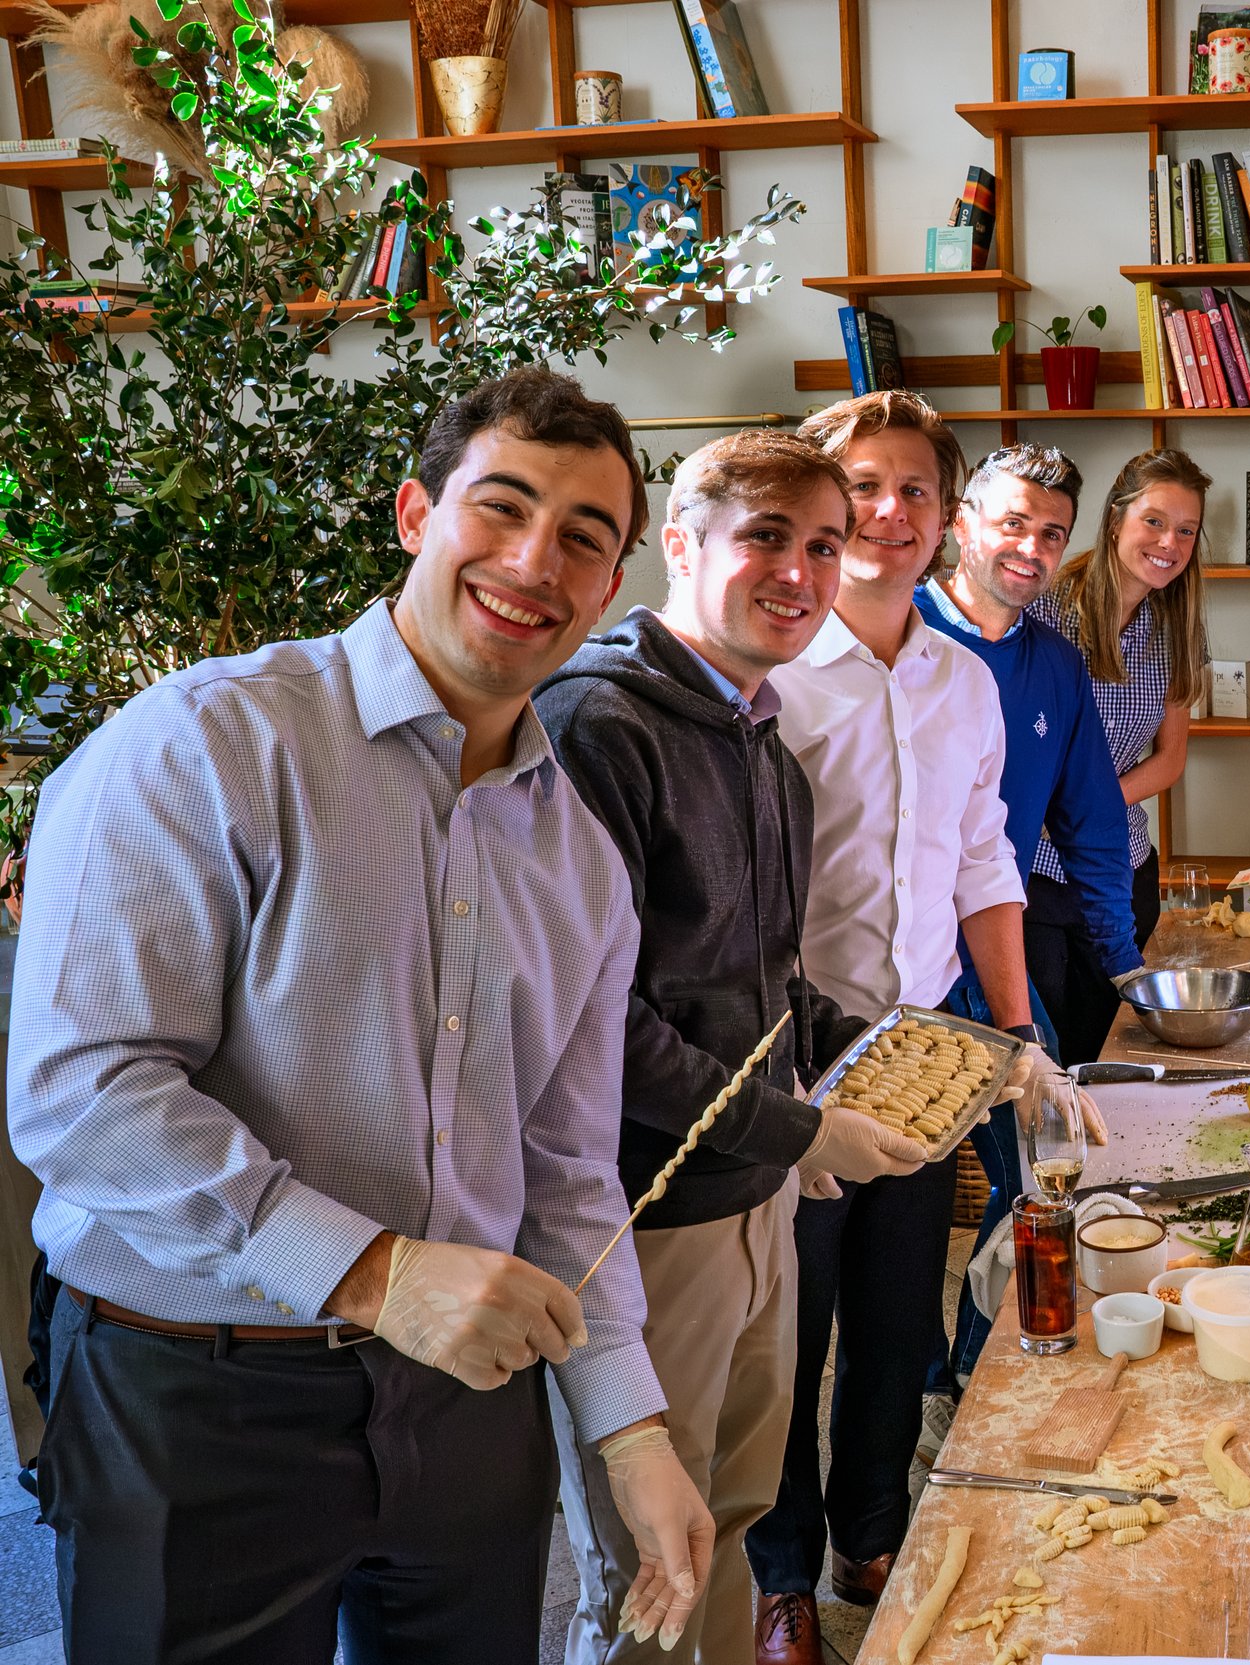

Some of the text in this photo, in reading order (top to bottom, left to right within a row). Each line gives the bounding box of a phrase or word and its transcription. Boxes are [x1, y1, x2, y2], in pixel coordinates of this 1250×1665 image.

[1225, 171, 1234, 195] BARBER
[1149, 193, 1158, 254] NEGRONI
[1205, 183, 1221, 237] DRINK
[378, 229, 394, 273] THE PICNIC
[1139, 313, 1147, 325] OF
[1140, 325, 1151, 366] GARDENS
[1212, 322, 1230, 355] CULTURED
[1222, 354, 1237, 378] FOODS
